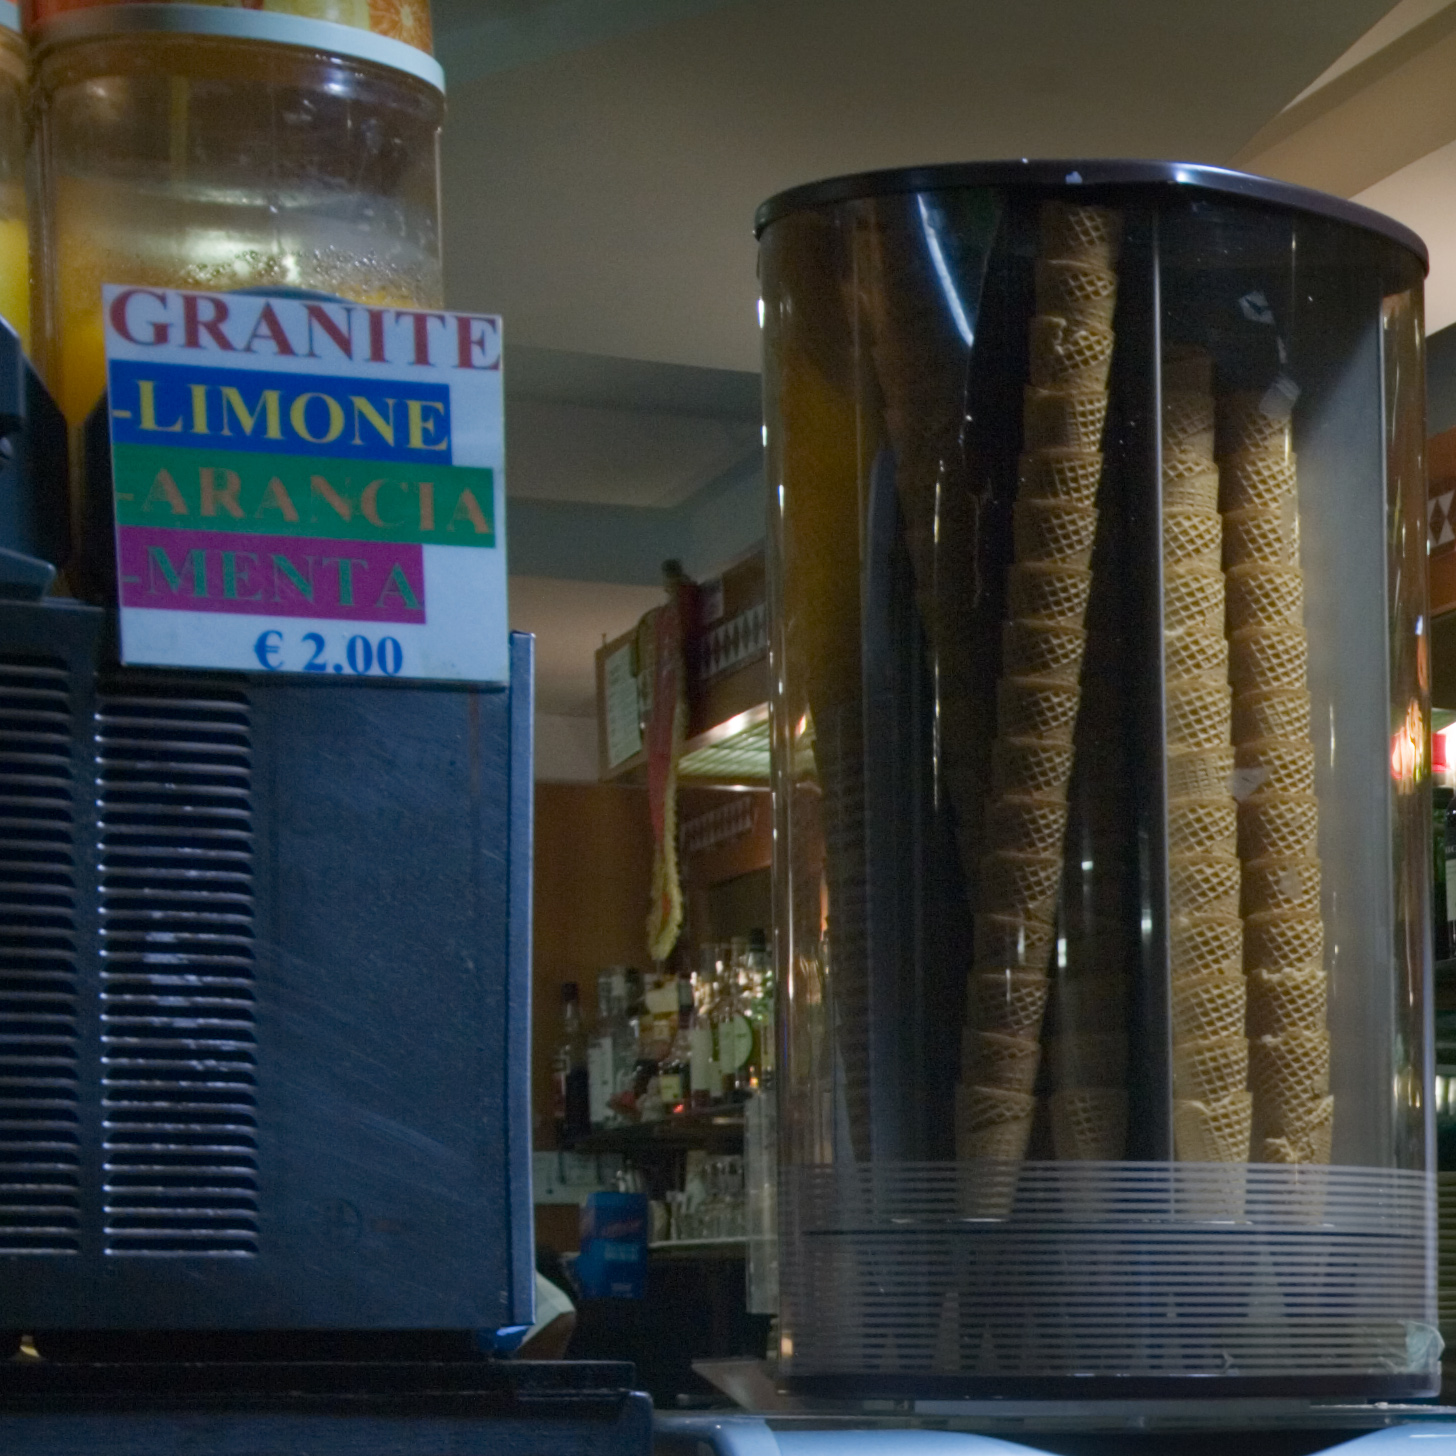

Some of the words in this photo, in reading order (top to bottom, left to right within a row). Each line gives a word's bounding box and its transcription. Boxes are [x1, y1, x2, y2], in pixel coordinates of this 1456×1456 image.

[109, 288, 500, 370] GRANITE
[254, 630, 284, 671] €
[300, 631, 403, 676] 2.00
